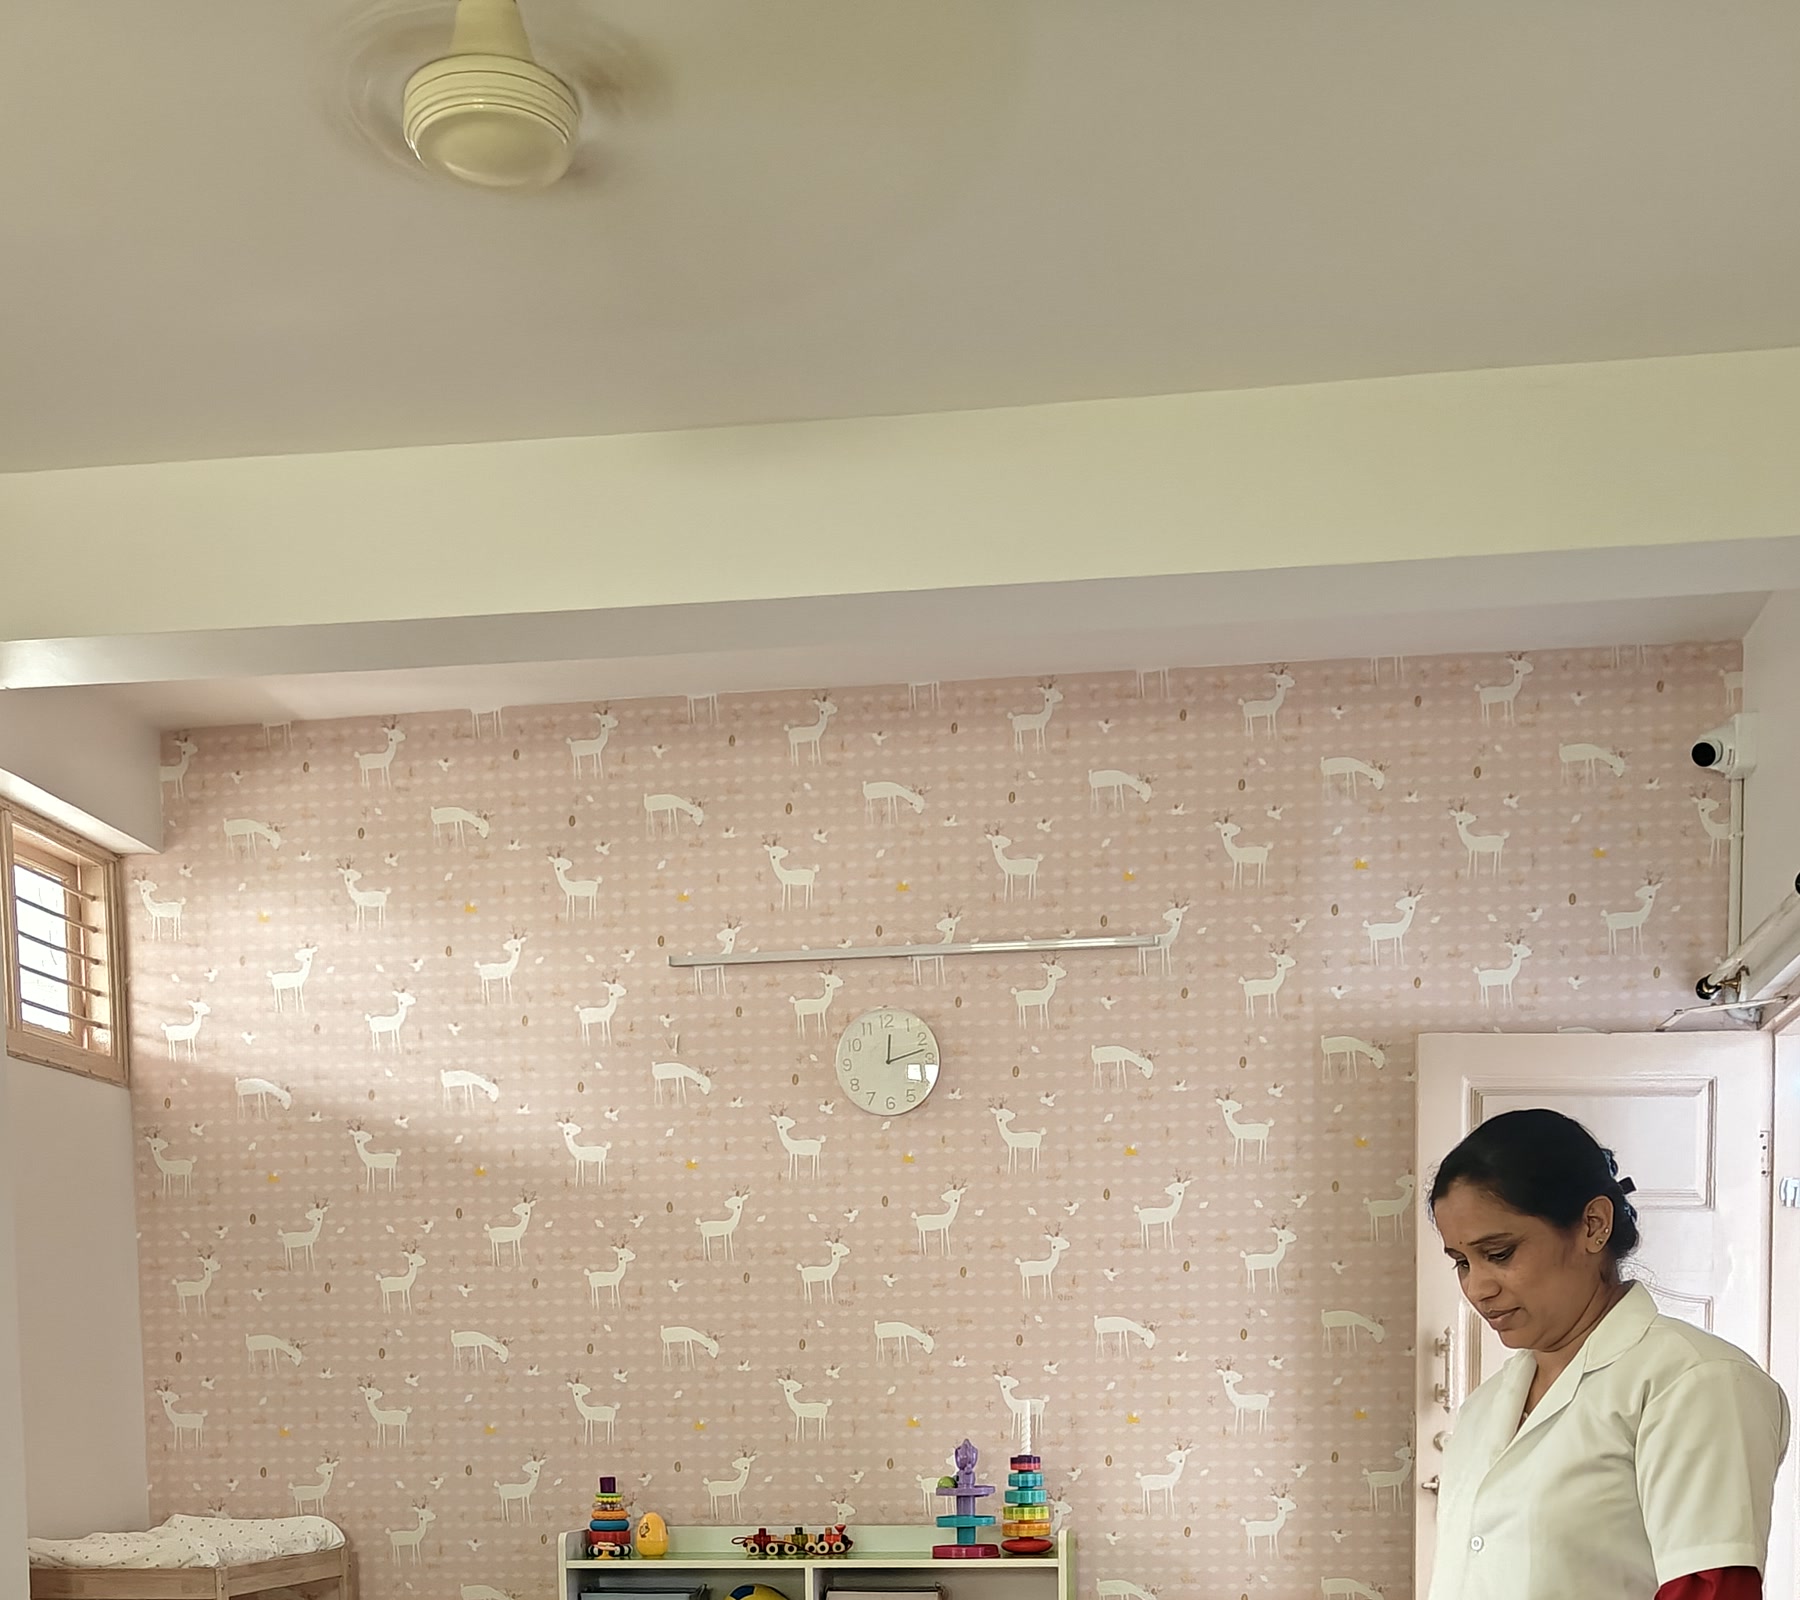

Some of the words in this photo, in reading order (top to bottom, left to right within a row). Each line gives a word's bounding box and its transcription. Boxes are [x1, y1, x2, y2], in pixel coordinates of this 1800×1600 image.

[879, 1014, 894, 1029] 12
[906, 1018, 910, 1032] 1
[862, 1022, 872, 1036] 11
[847, 1038, 862, 1052] 10
[918, 1032, 928, 1046] 2
[842, 1058, 852, 1072] 9
[850, 1078, 860, 1092] 8
[866, 1091, 876, 1106] 7
[885, 1096, 896, 1110] 6
[906, 1089, 916, 1103] 5
